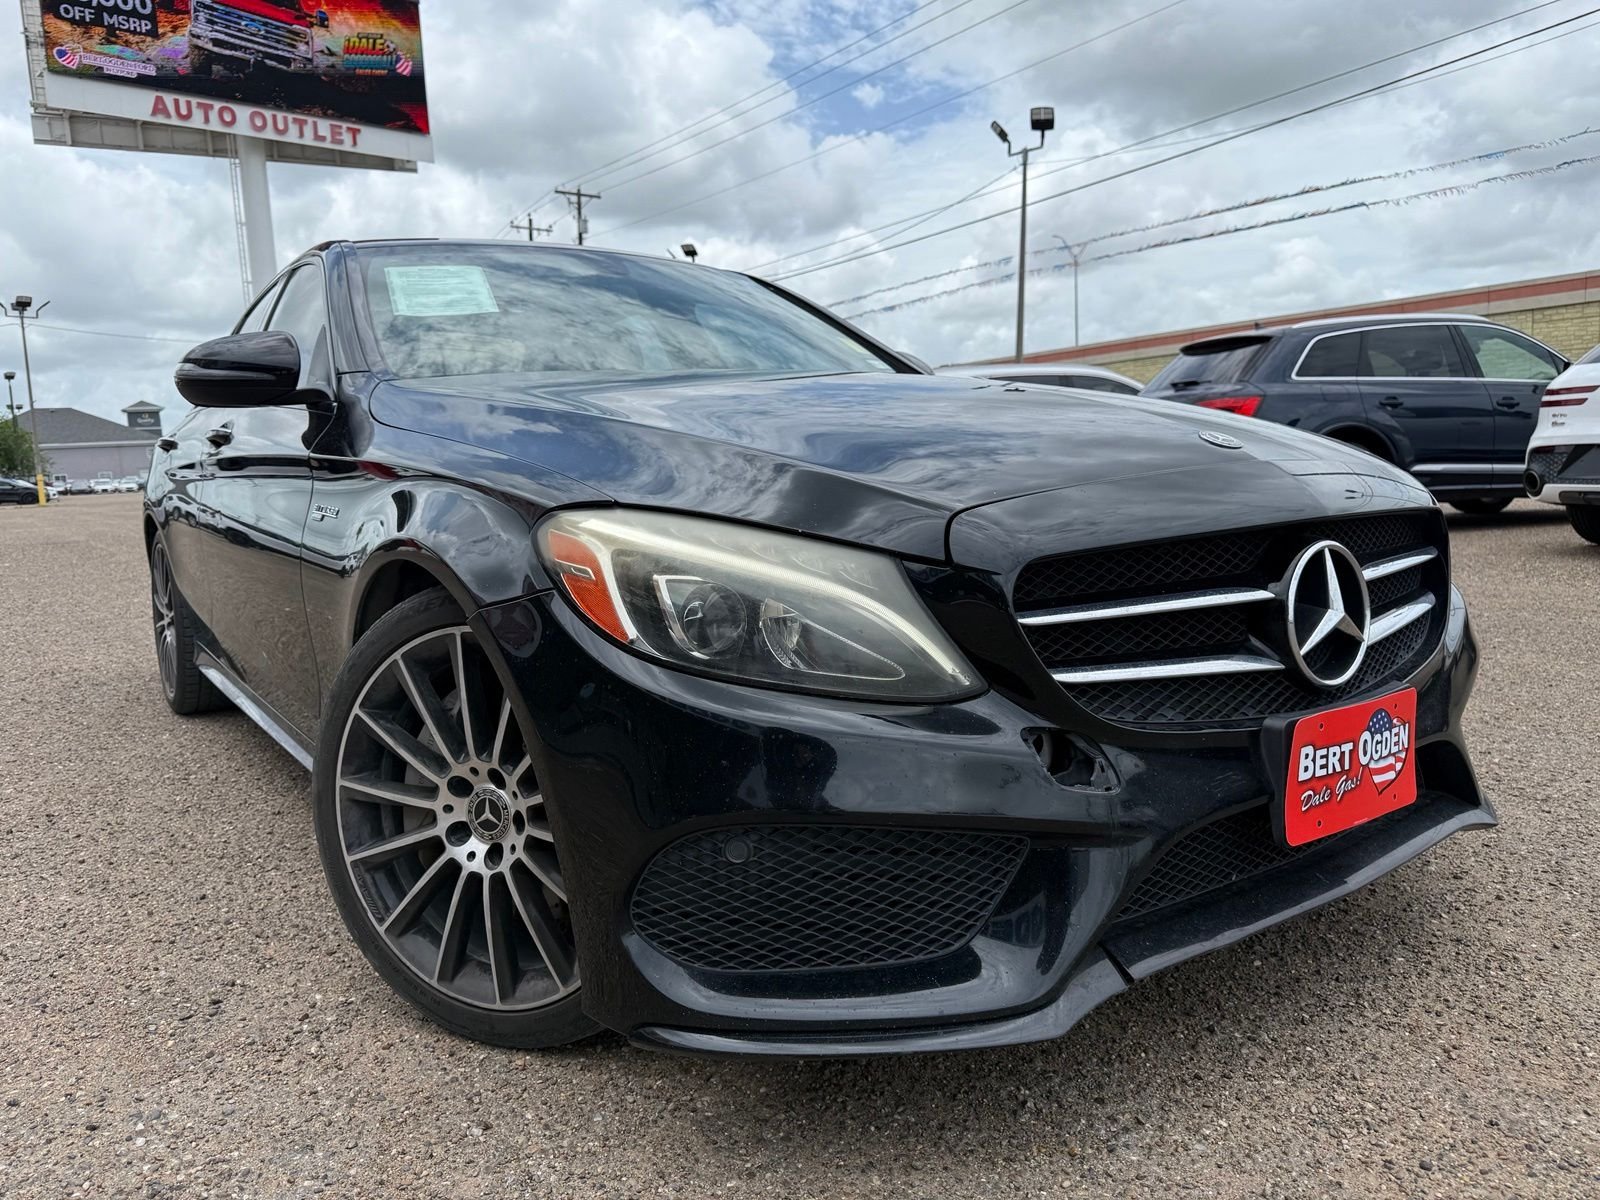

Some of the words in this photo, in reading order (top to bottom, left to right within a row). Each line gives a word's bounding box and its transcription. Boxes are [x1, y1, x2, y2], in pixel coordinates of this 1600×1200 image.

[59, 4, 95, 22] OFF
[103, 12, 152, 33] MSRP
[150, 95, 237, 127] AUTO
[249, 110, 361, 147] OUTLET
[1298, 742, 1353, 781] BERT
[1358, 723, 1409, 766] OGDEN
[1300, 786, 1331, 812] Dale
[1336, 767, 1363, 801] Gas!
